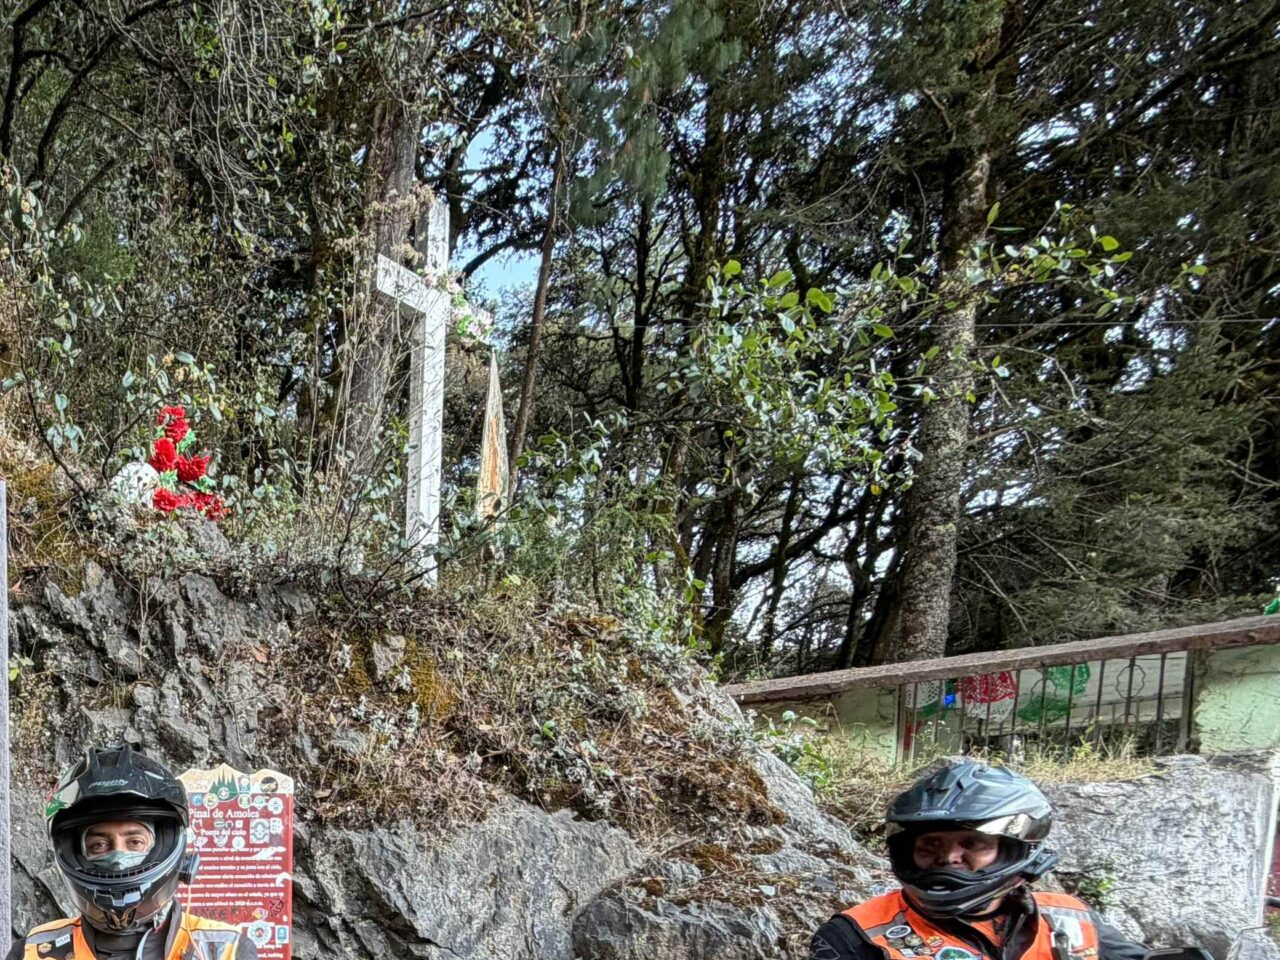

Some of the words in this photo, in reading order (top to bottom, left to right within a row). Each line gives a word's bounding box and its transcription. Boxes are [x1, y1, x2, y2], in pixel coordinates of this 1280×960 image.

[188, 808, 211, 819] Pinal
[215, 808, 226, 819] de
[227, 809, 260, 819] Amoles
